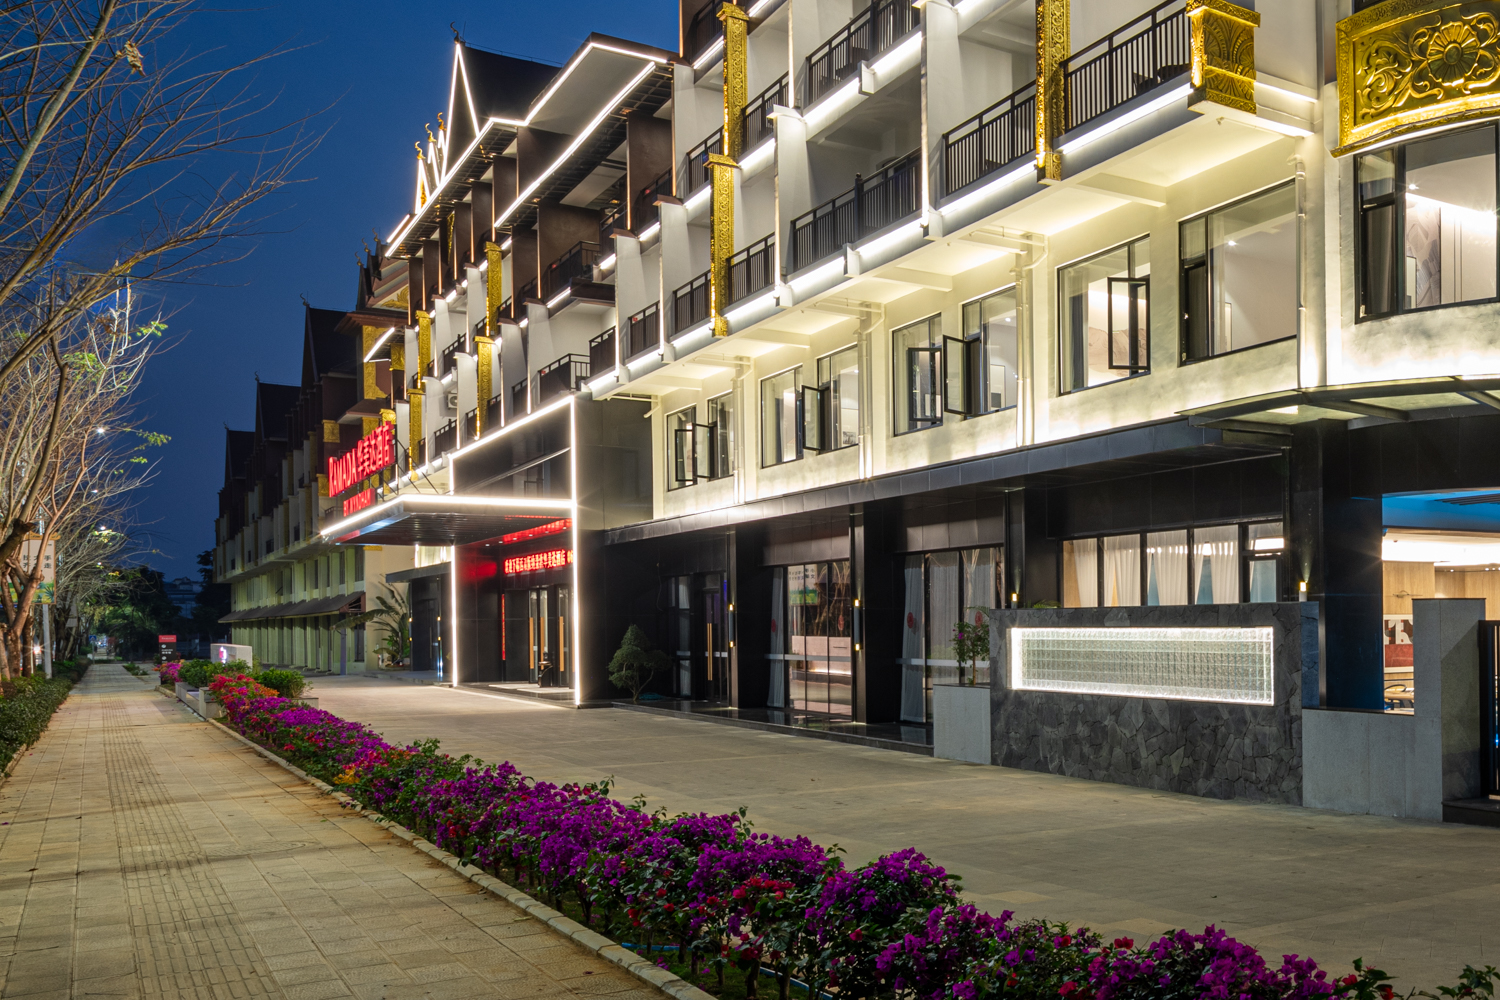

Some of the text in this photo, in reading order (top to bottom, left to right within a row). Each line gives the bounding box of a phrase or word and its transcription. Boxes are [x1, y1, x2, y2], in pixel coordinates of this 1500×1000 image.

[328, 421, 394, 498] RAMADA 华美达酒店
[350, 488, 374, 514] WYNDHAM
